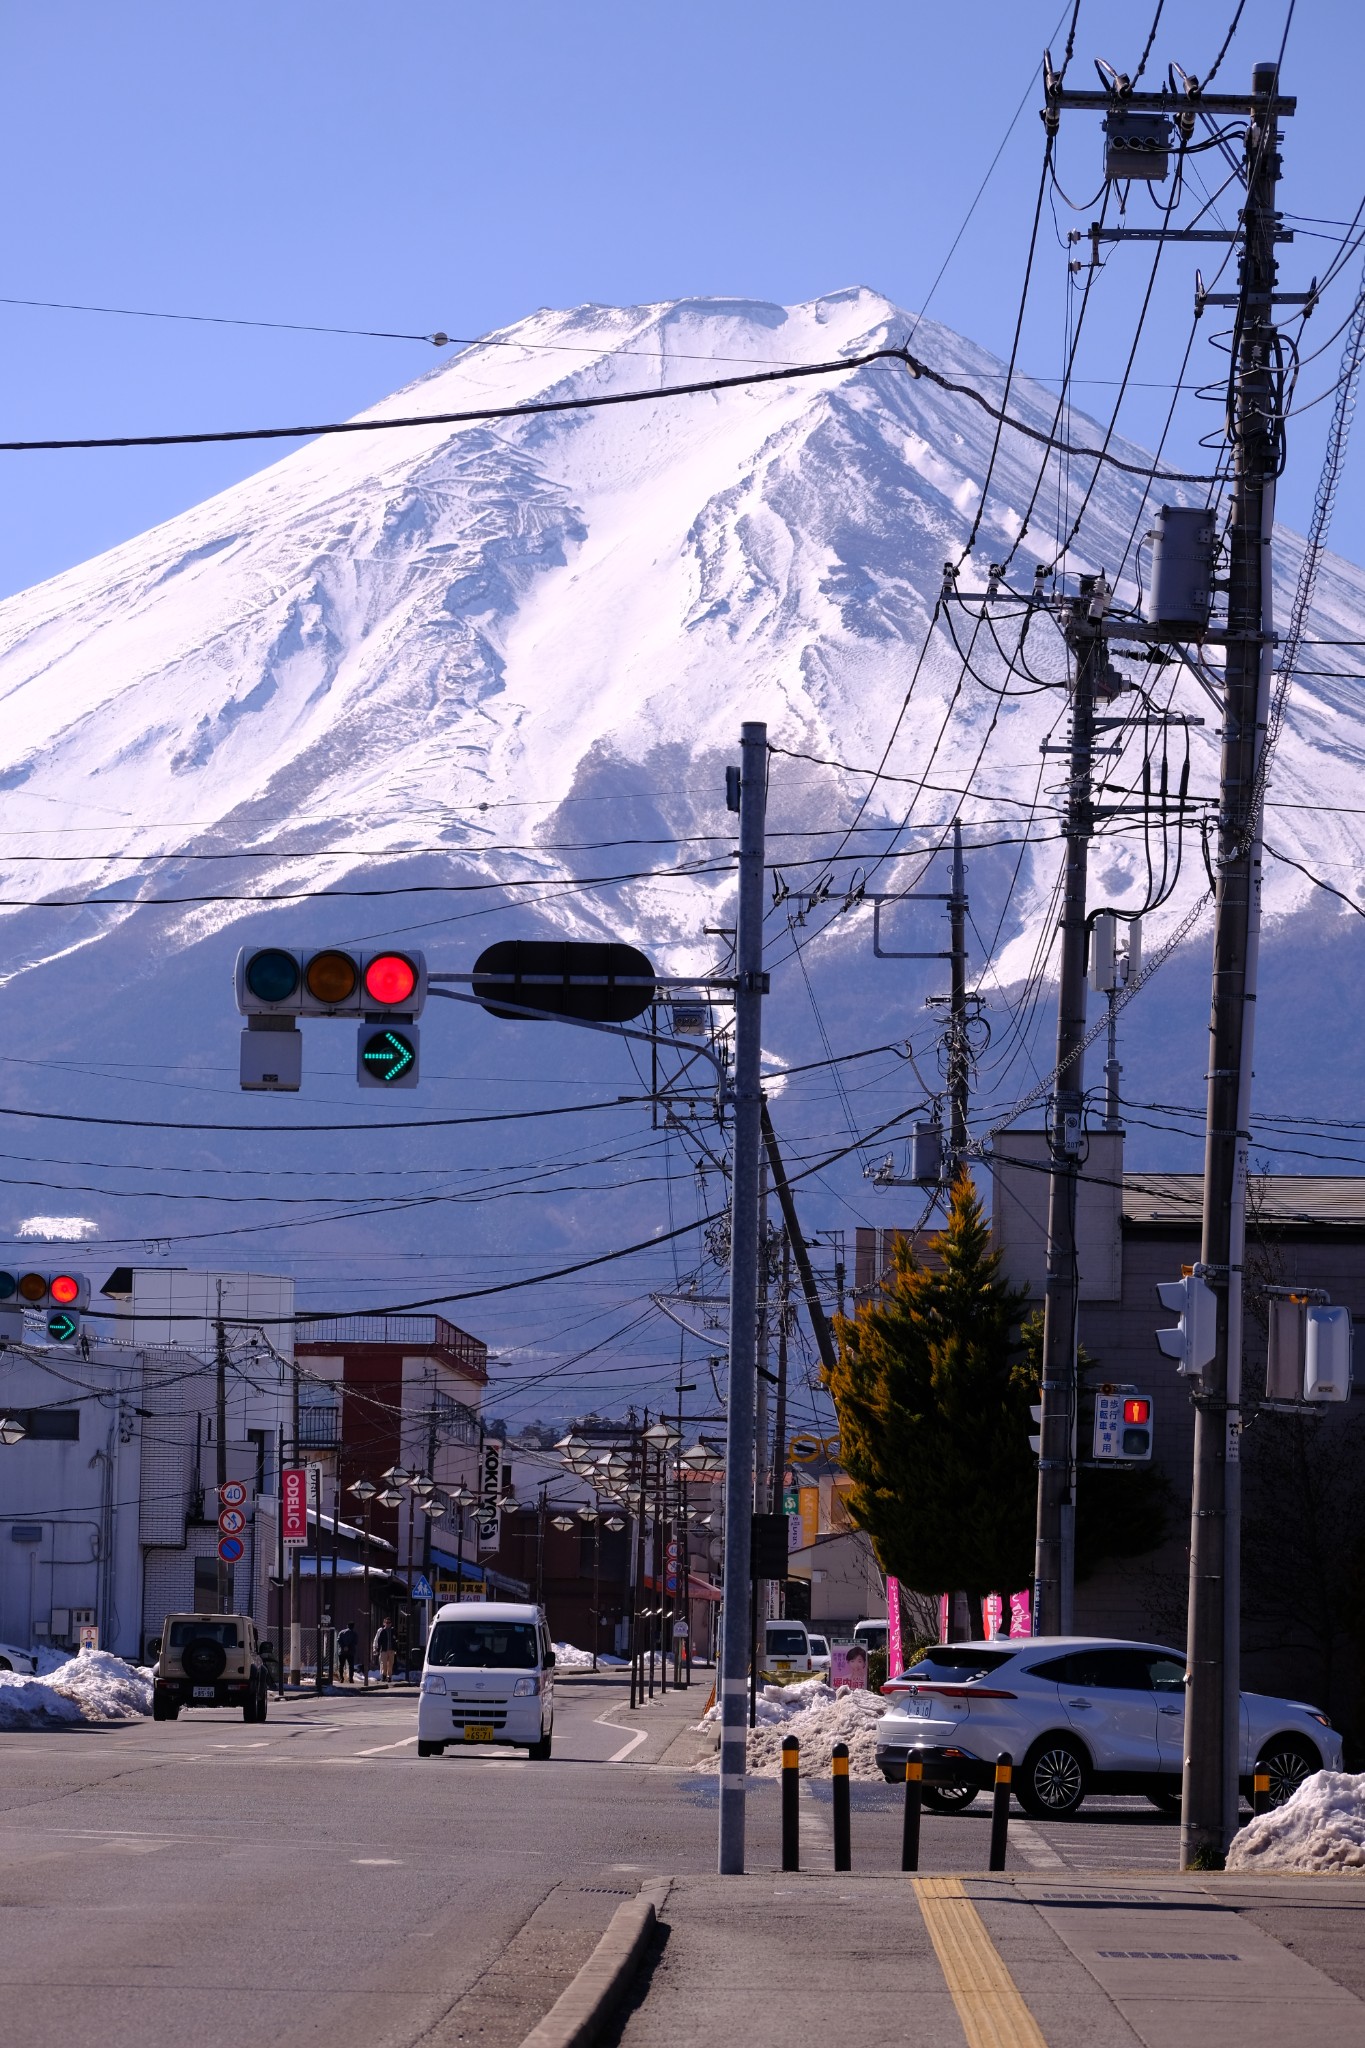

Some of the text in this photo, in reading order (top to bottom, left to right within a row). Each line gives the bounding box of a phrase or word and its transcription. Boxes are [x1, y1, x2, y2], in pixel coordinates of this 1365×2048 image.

[1099, 1400, 1108, 1430] 自転車
[1109, 1400, 1118, 1430] 歩行者
[1102, 1432, 1111, 1453] 専用
[226, 1488, 240, 1499] 40
[286, 1474, 300, 1529] ODELIC
[471, 1732, 491, 1740] 65-71
